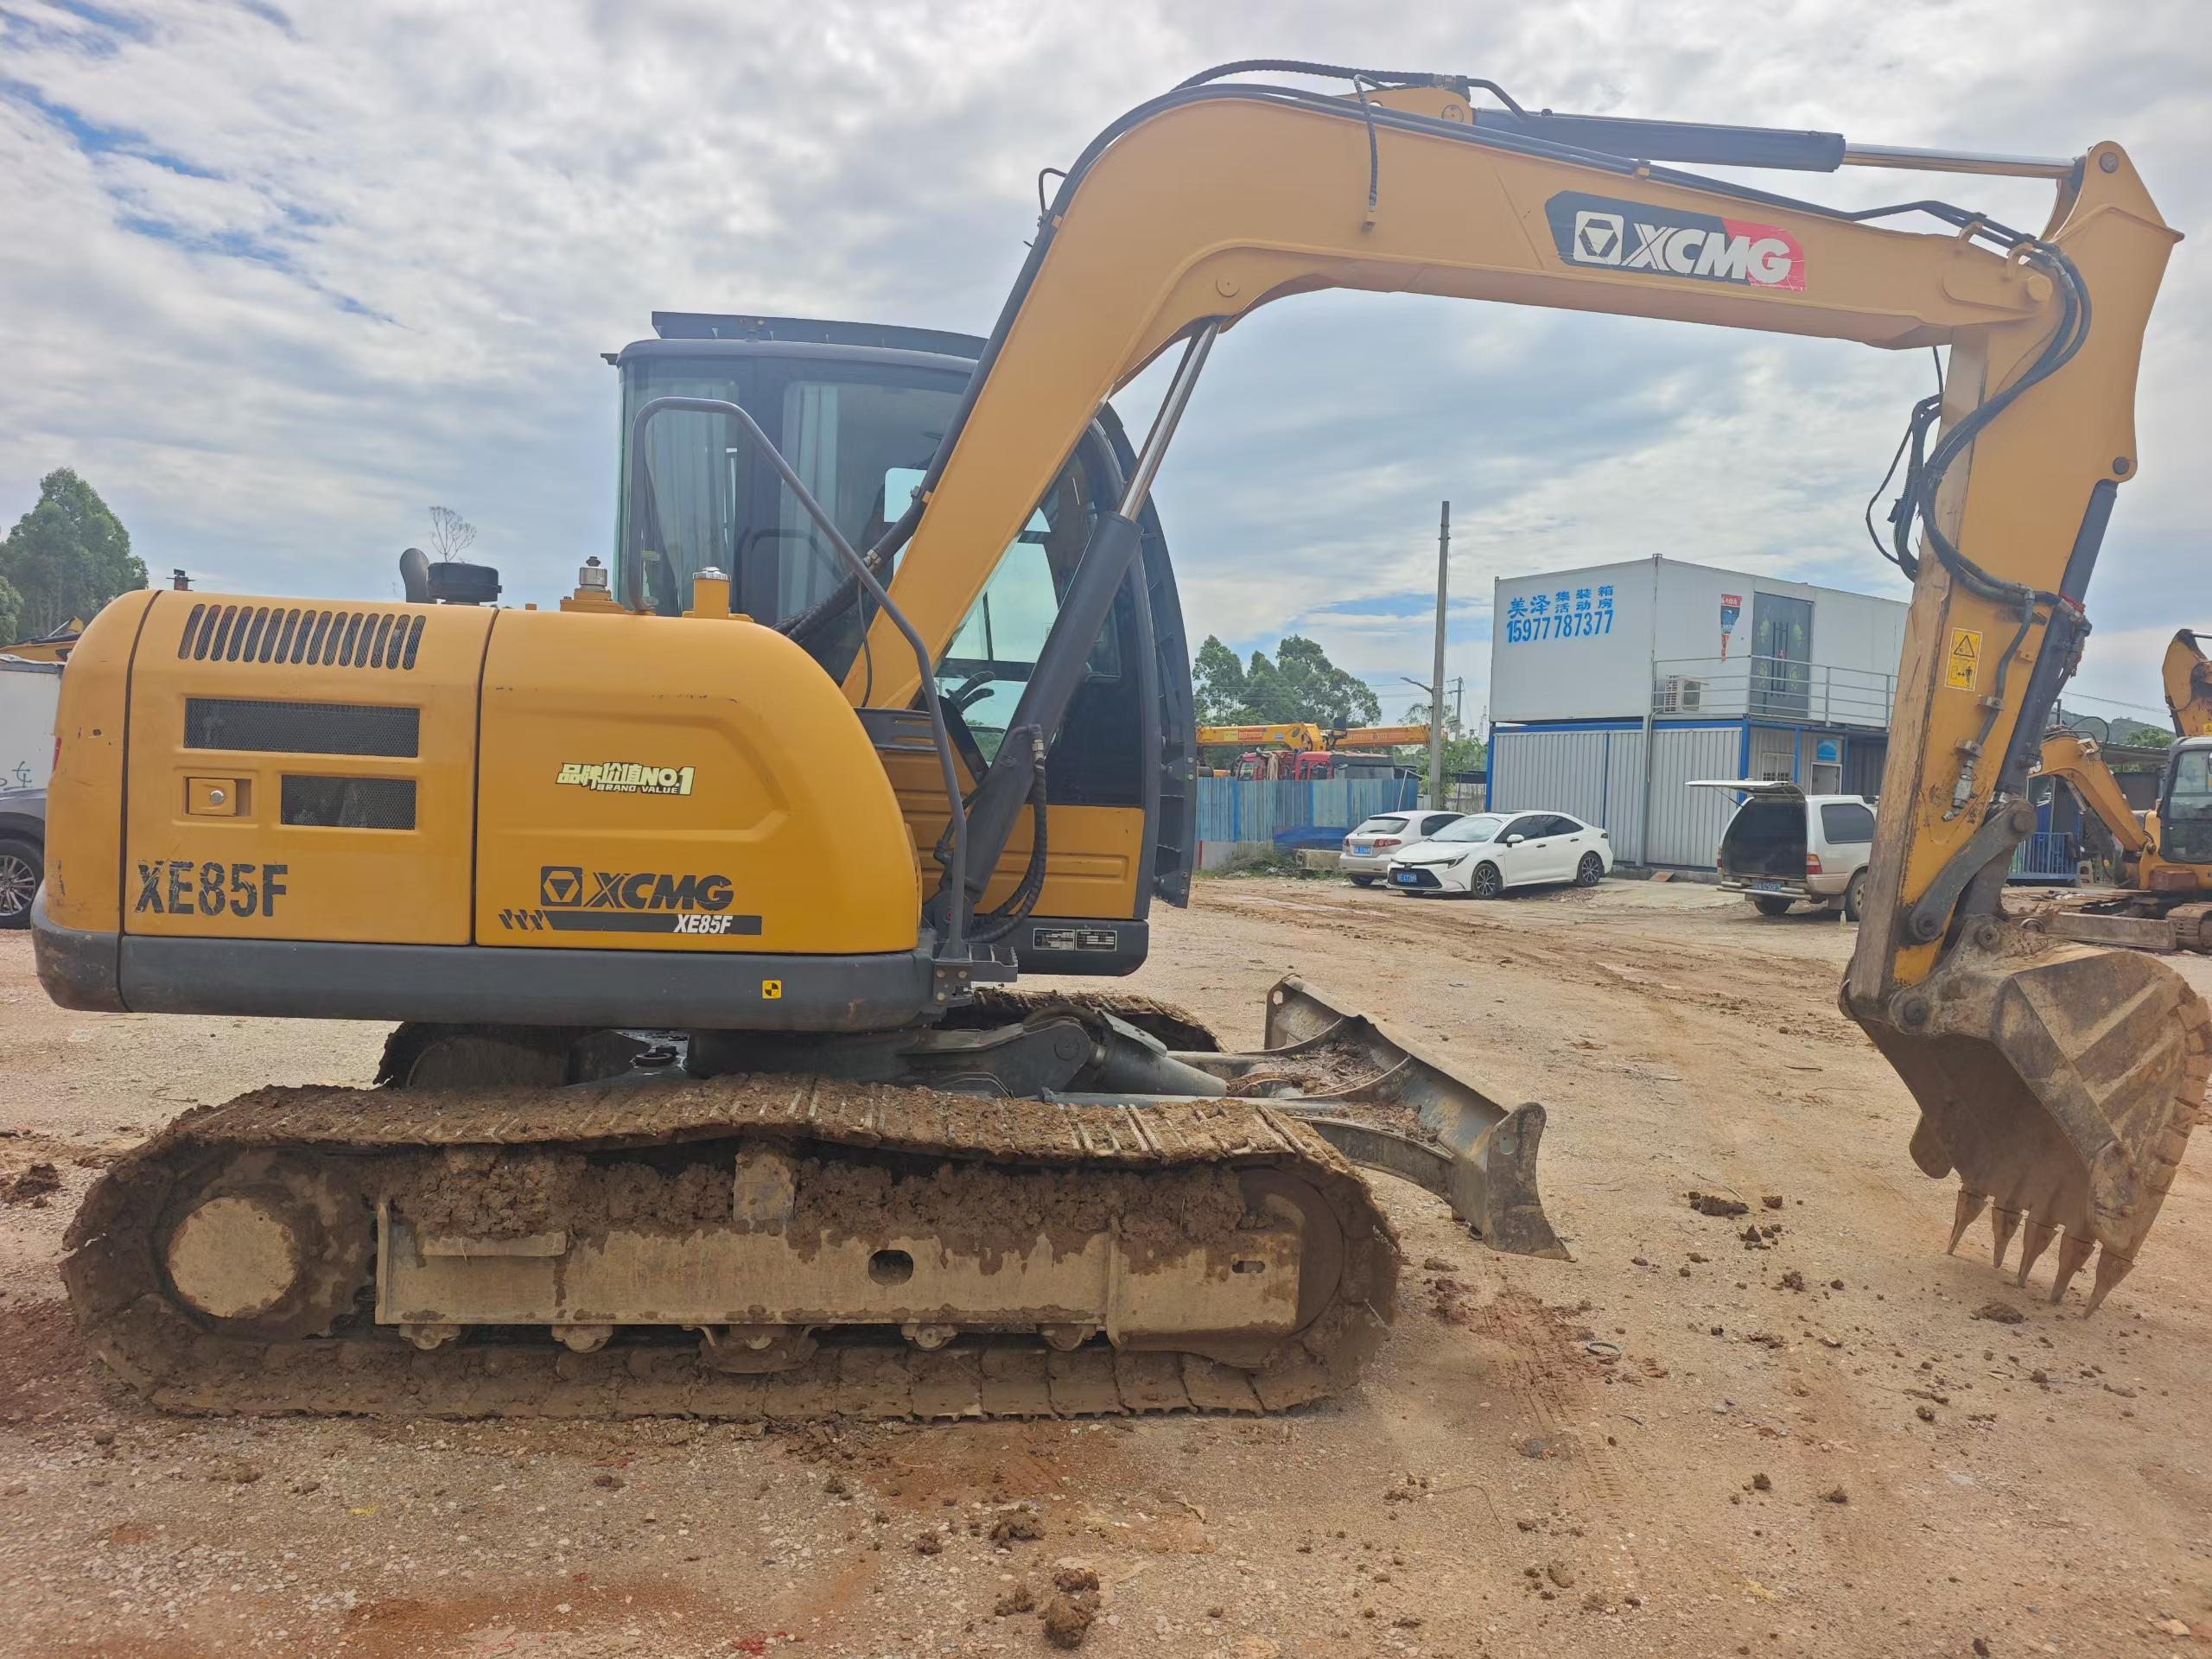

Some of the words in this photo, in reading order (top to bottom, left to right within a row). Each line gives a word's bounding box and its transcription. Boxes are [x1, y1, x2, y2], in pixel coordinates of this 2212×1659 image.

[1621, 223, 1792, 283] XCMG
[1555, 586, 1614, 601] 集装箱
[1507, 594, 1551, 619] 美泽
[1554, 598, 1613, 614] 活动房
[597, 784, 637, 792] BRAND
[641, 785, 678, 794] VALUE
[135, 861, 288, 918] XE85F
[583, 872, 734, 911] XCMG
[673, 914, 734, 934] XE85F
